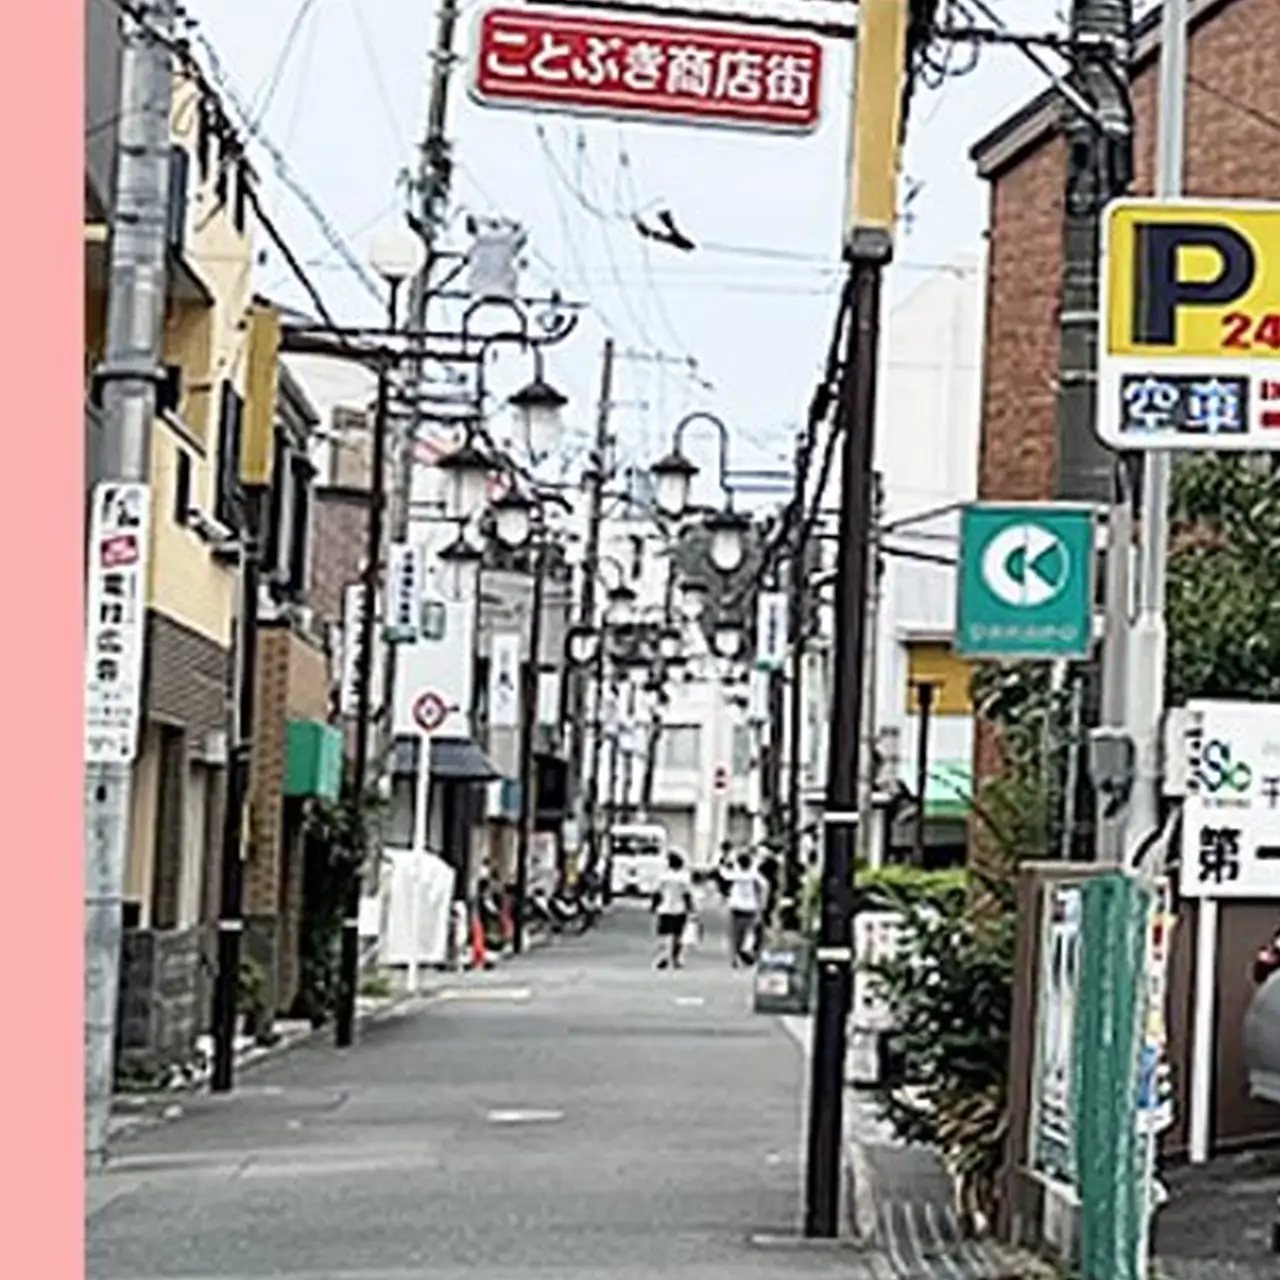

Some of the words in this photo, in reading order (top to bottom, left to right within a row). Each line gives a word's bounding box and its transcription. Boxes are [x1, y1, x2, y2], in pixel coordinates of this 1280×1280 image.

[486, 30, 813, 105] ことぶき商店街
[1131, 220, 1257, 347] P
[1123, 375, 1242, 434] 空車
